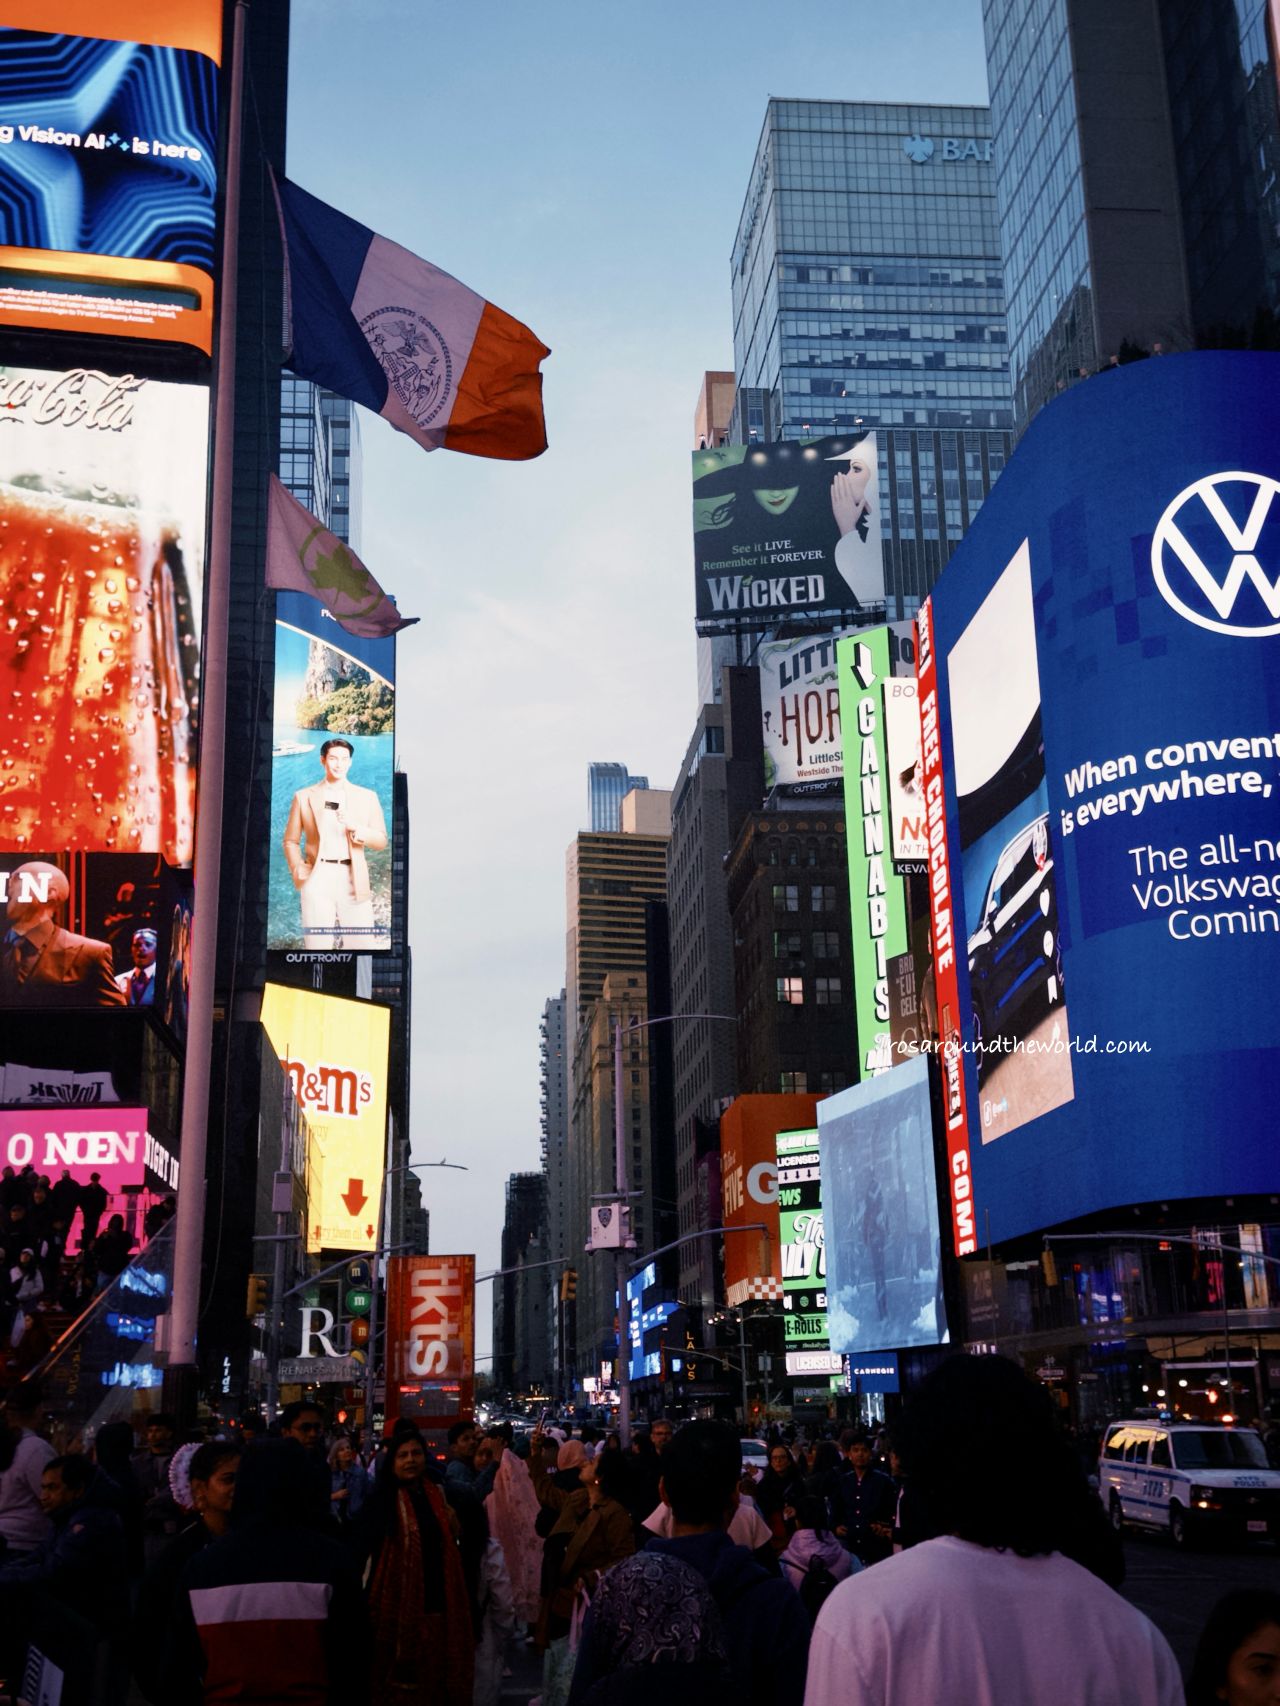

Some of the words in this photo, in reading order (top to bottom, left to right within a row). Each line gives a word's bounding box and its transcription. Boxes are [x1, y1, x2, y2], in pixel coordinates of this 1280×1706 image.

[18, 125, 81, 147] Vision
[84, 133, 106, 150] AI
[132, 137, 149, 154] is
[152, 140, 202, 161] here
[703, 556, 758, 570] Remember
[759, 555, 769, 565] it
[770, 550, 826, 564] FOREVER.
[731, 545, 751, 555] See
[754, 542, 762, 553] it
[764, 539, 794, 551] LIVE.
[921, 692, 942, 780] FREE
[797, 769, 830, 781] Westside
[1064, 753, 1138, 798] When
[1060, 808, 1074, 837] is
[1076, 769, 1273, 828] everywhere,
[857, 697, 890, 1024] CANNABIS
[1128, 845, 1187, 876] The
[1200, 834, 1280, 866] all-n
[927, 782, 958, 977] CHOCOLATE
[1168, 904, 1280, 940] Comin
[724, 1165, 744, 1218] FIVE
[952, 1149, 975, 1257] COME
[354, 1295, 366, 1306] m
[410, 1264, 462, 1376] tkts
[296, 1307, 350, 1359] R
[854, 1367, 895, 1375] CARNEGIE
